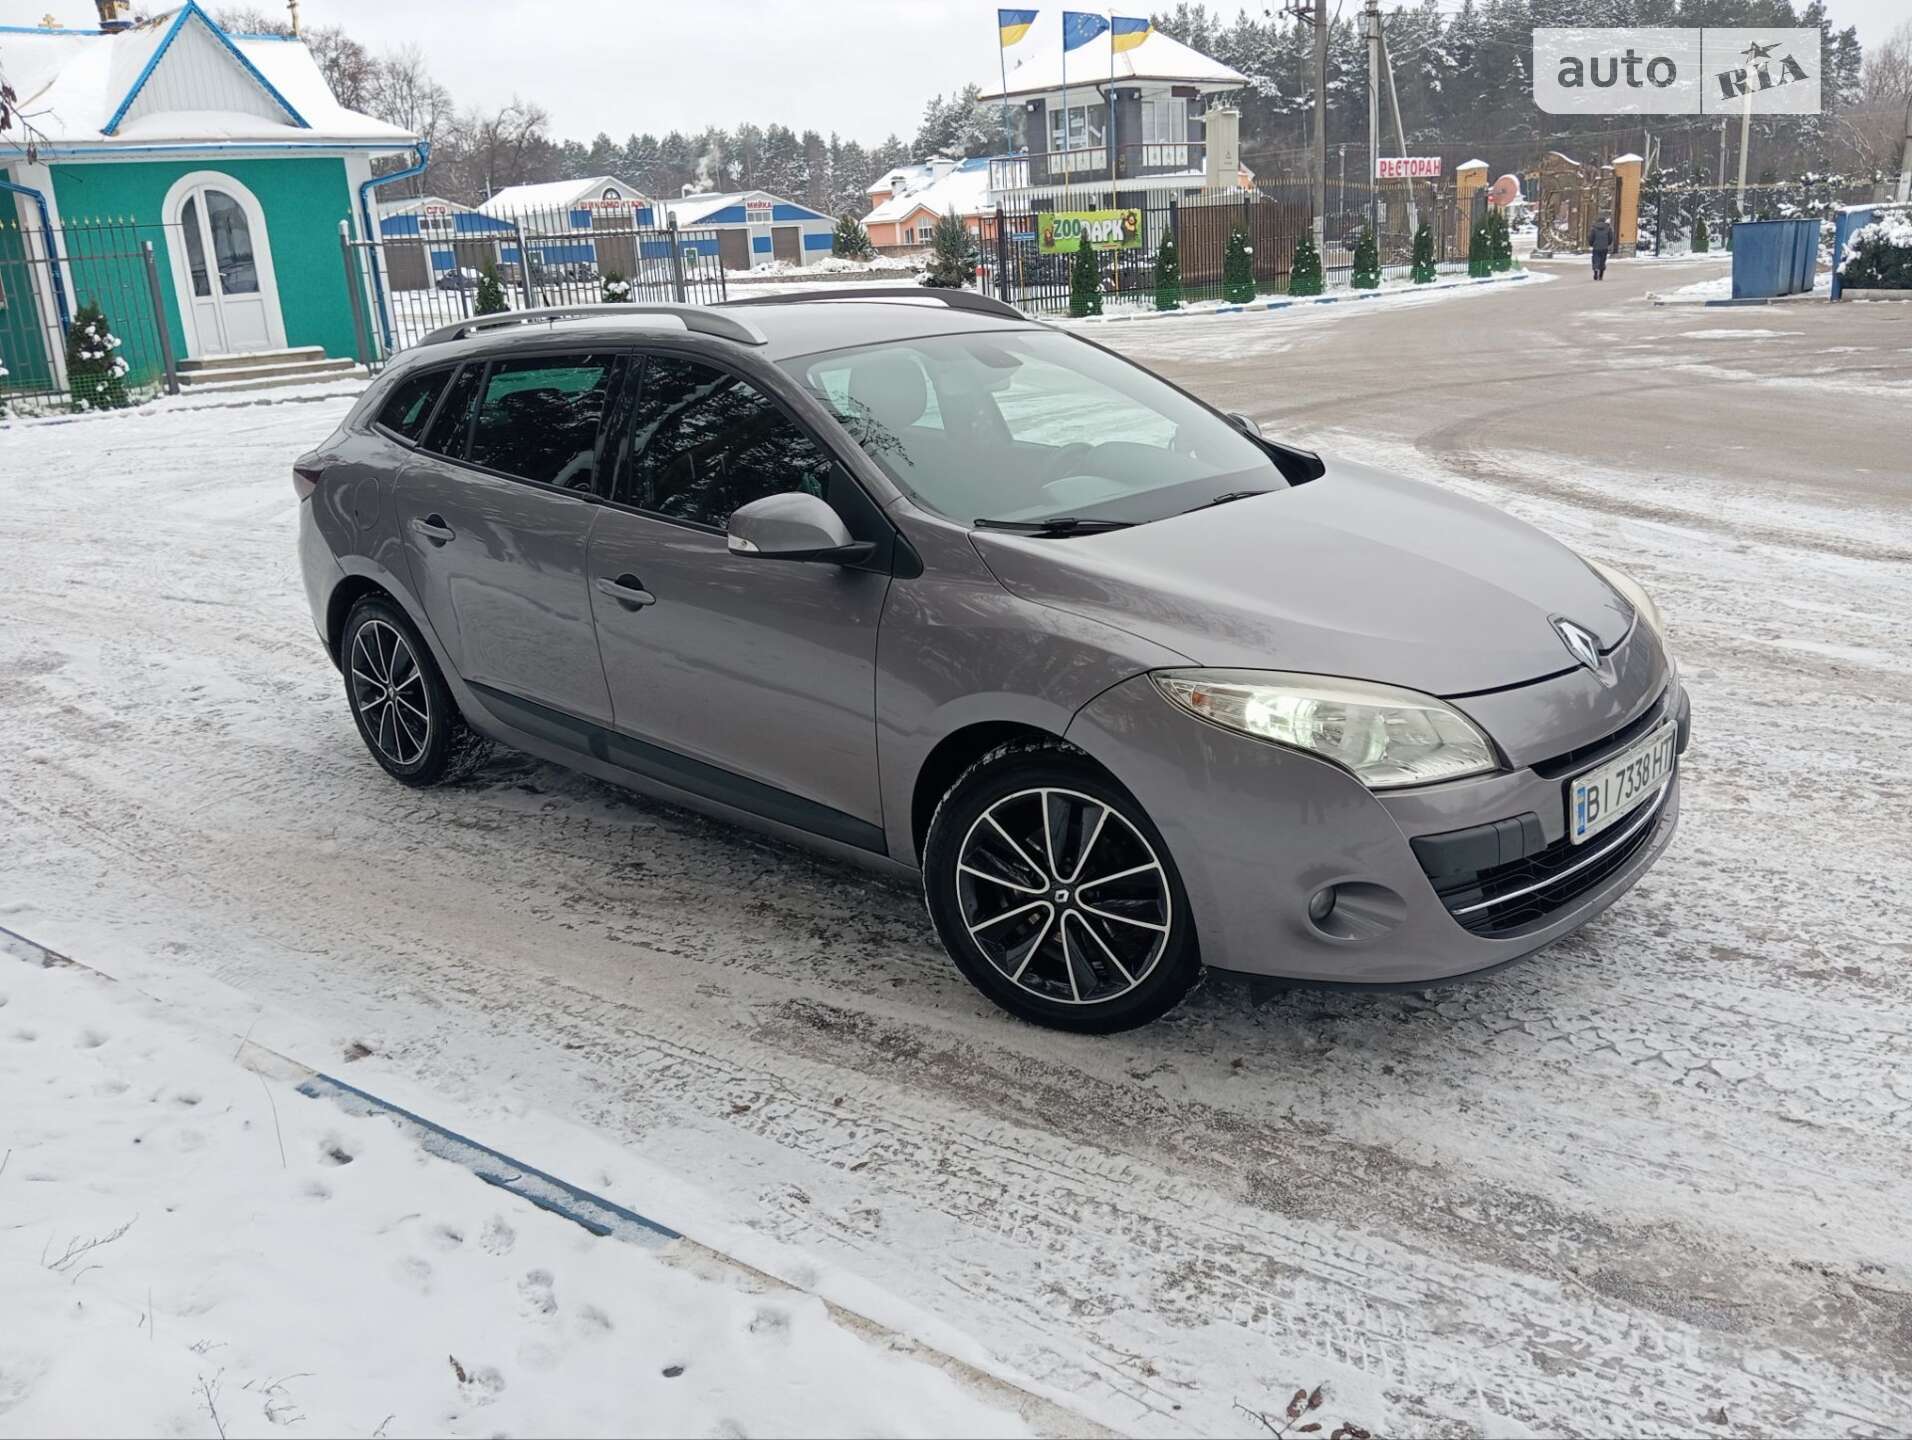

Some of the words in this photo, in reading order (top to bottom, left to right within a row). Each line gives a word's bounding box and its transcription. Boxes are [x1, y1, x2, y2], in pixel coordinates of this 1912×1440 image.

[1379, 160, 1441, 177] РЕСТОРАН
[427, 206, 446, 214] СТО
[1616, 753, 1650, 806] 7338
[1652, 736, 1673, 779] HT
